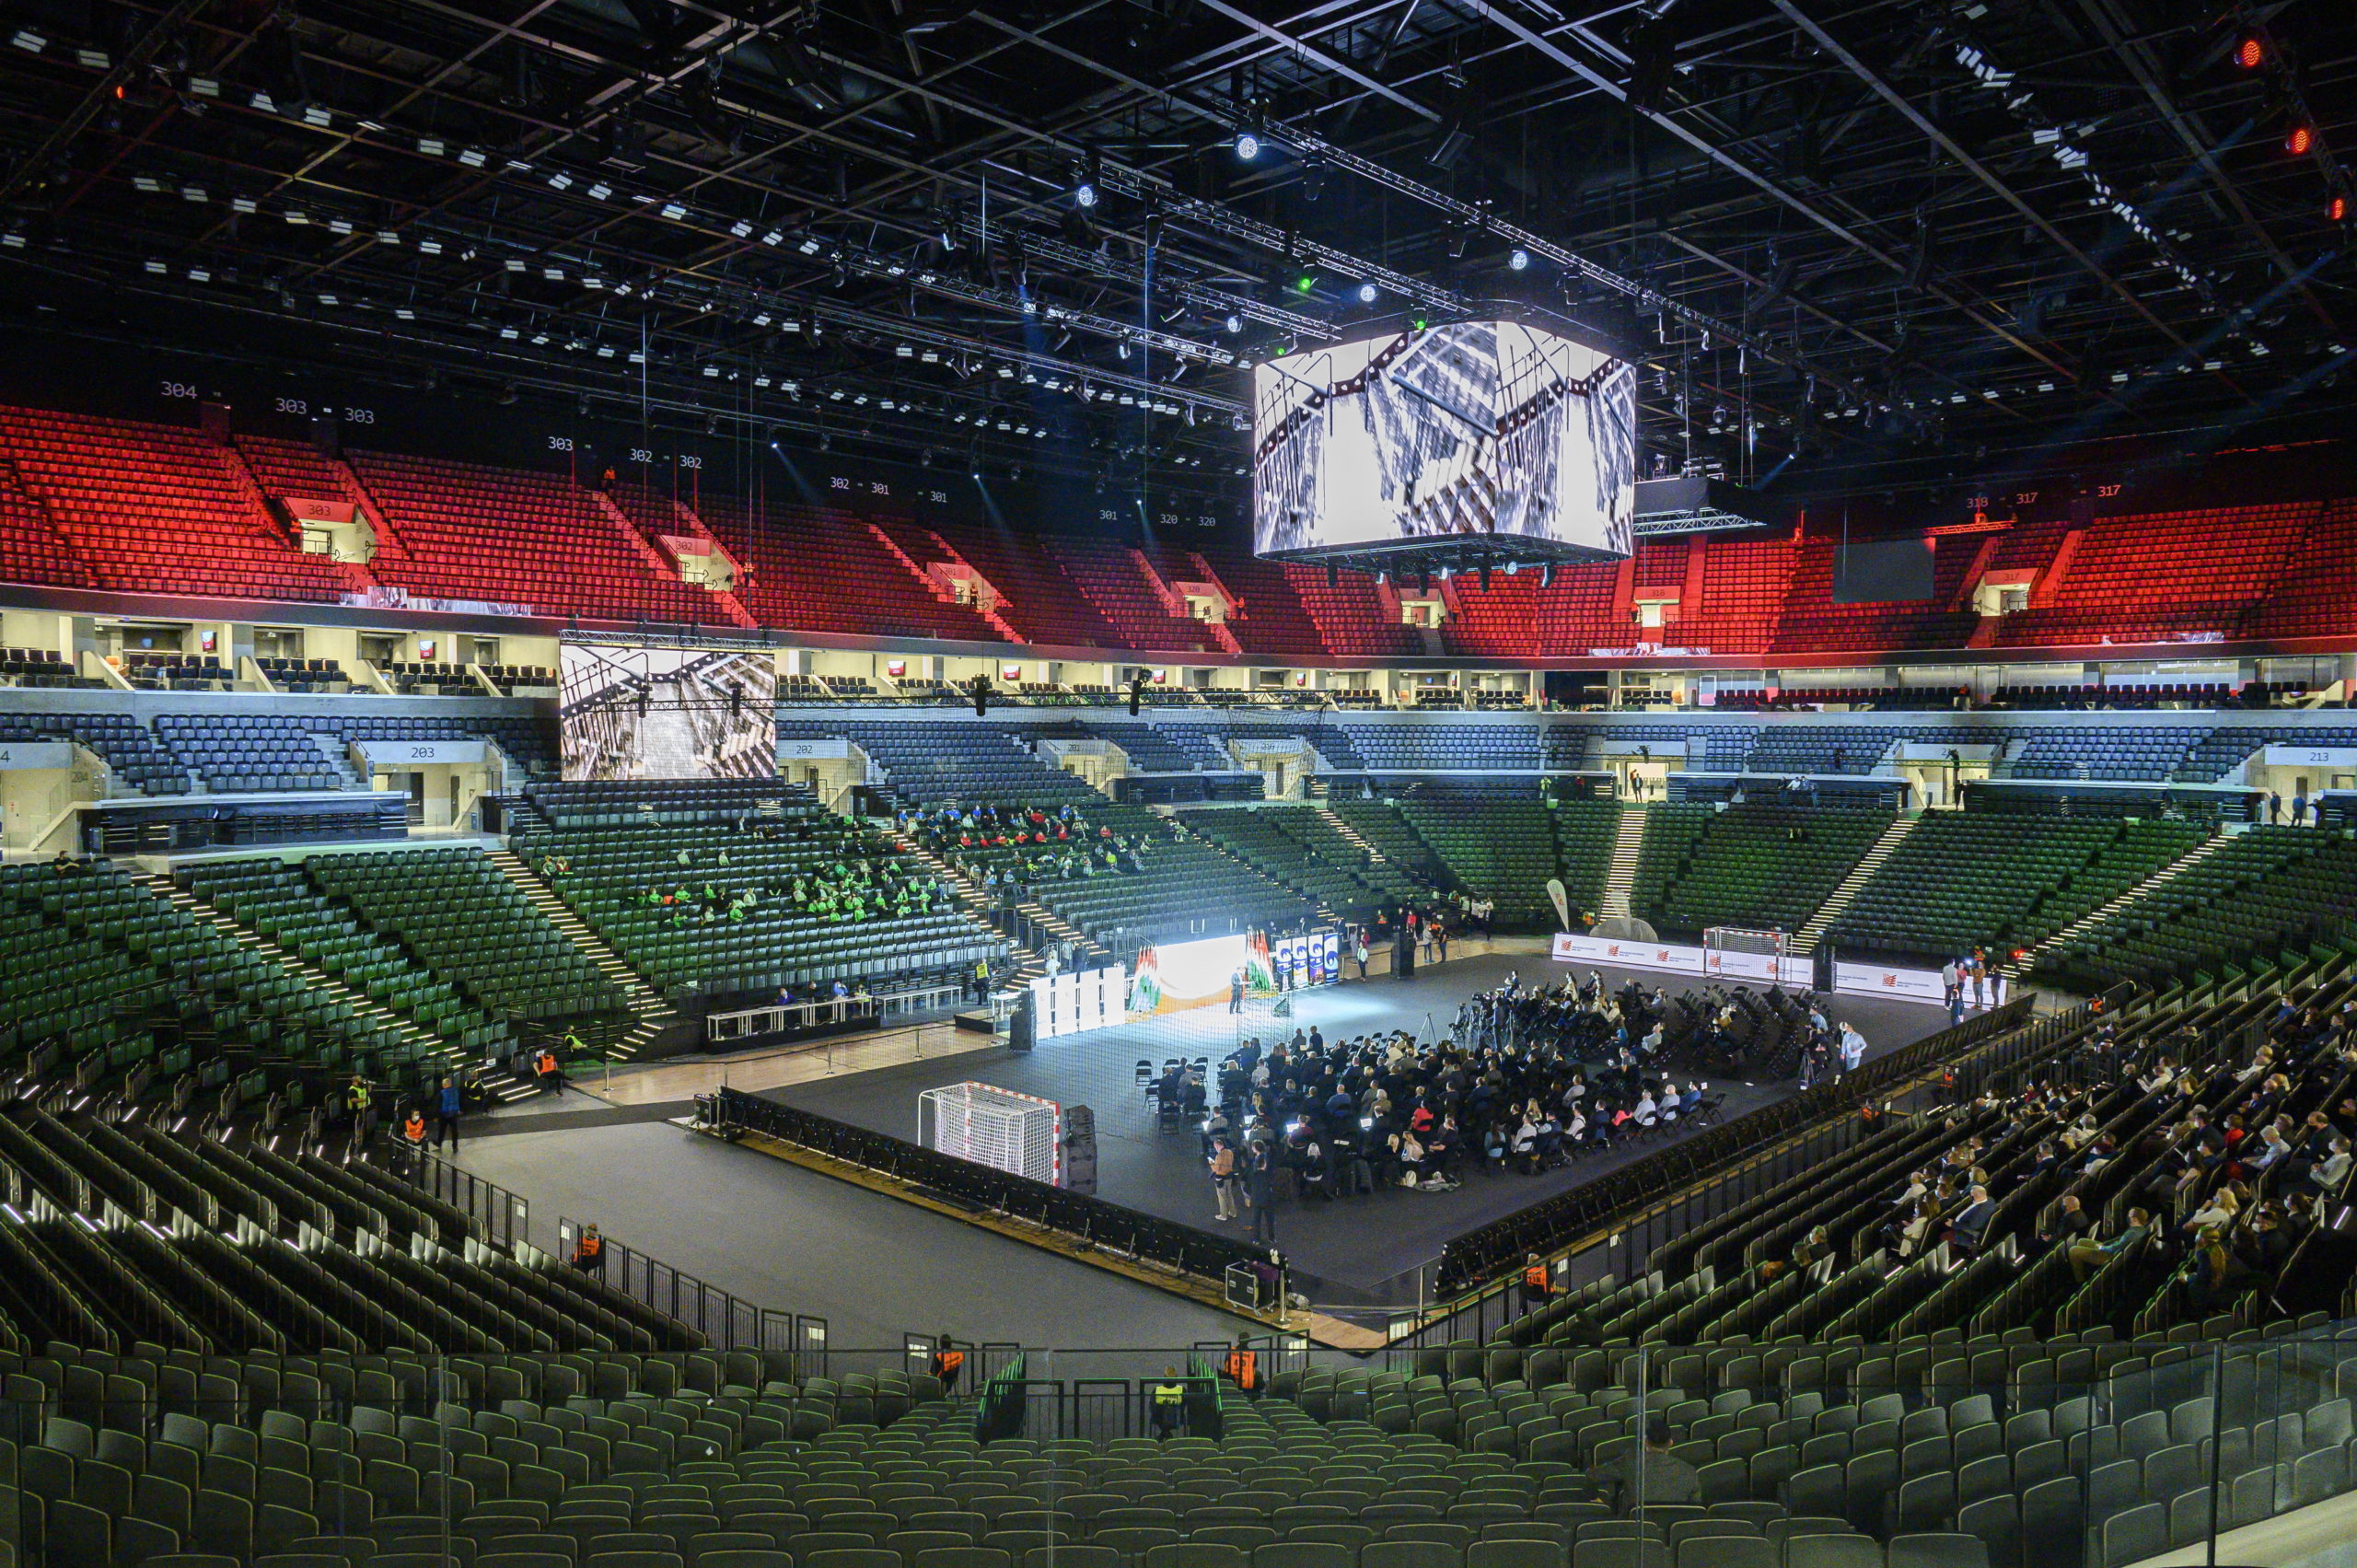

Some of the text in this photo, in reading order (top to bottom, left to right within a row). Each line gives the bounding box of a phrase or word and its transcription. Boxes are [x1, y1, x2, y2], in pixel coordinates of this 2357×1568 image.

[161, 381, 198, 399] 304
[275, 398, 307, 414] 303
[344, 407, 375, 424] 303
[548, 436, 573, 451] 303
[630, 448, 653, 462] 302
[679, 455, 702, 469] 302
[830, 477, 850, 490] 302
[871, 482, 889, 495] 301
[2097, 484, 2121, 497] 317
[930, 491, 947, 503] 301
[1967, 497, 1989, 508] 318
[2016, 492, 2038, 505] 317
[308, 505, 331, 516] 303
[1099, 509, 1118, 520] 301
[1160, 514, 1178, 525] 320
[1198, 516, 1216, 527] 320
[676, 540, 692, 551] 302
[2004, 573, 2019, 581] 317
[411, 747, 435, 758] 203
[795, 744, 813, 754] 202
[1636, 744, 1652, 752] 25
[2309, 752, 2328, 761] 213
